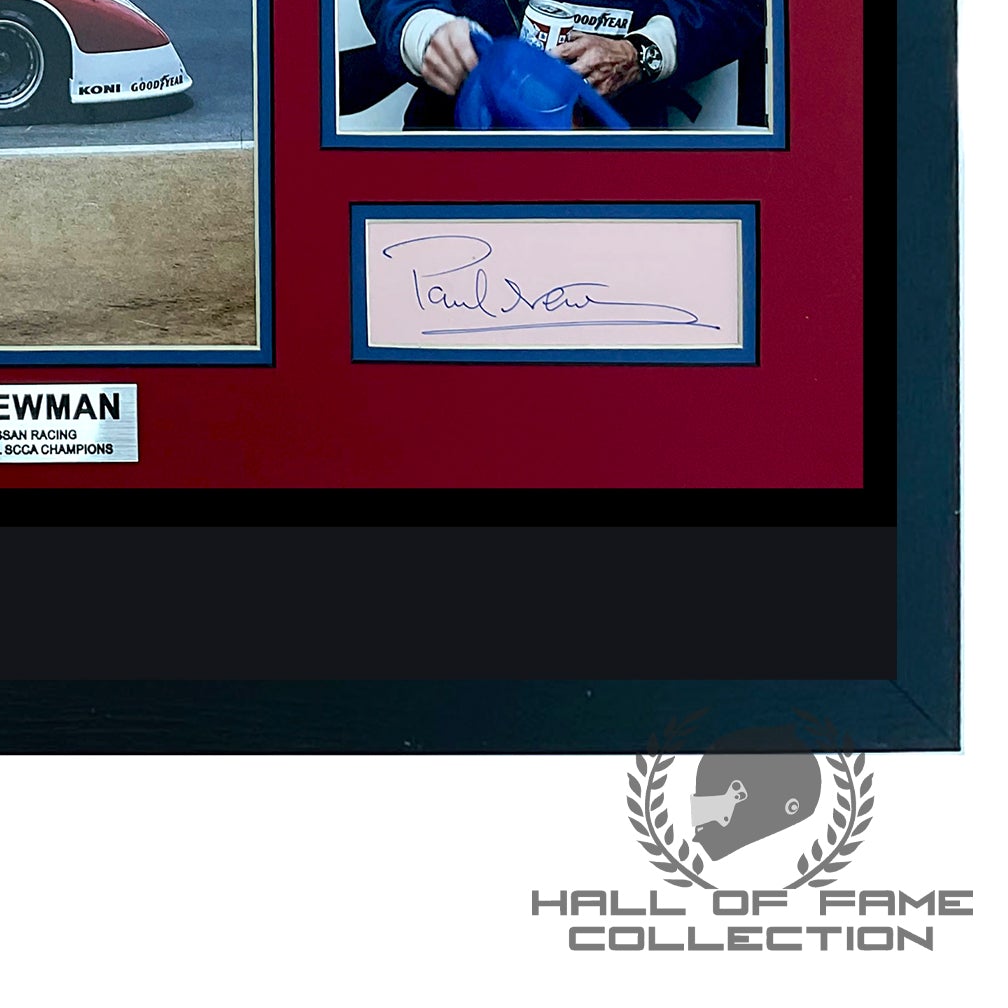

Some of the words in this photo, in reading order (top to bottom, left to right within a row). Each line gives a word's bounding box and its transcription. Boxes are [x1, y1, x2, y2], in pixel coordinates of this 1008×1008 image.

[131, 74, 184, 92] GOODYEAR
[78, 84, 120, 95] KONI
[32, 429, 77, 440] RACING
[4, 444, 38, 455] SCCA
[41, 443, 113, 455] CHAMPIONS
